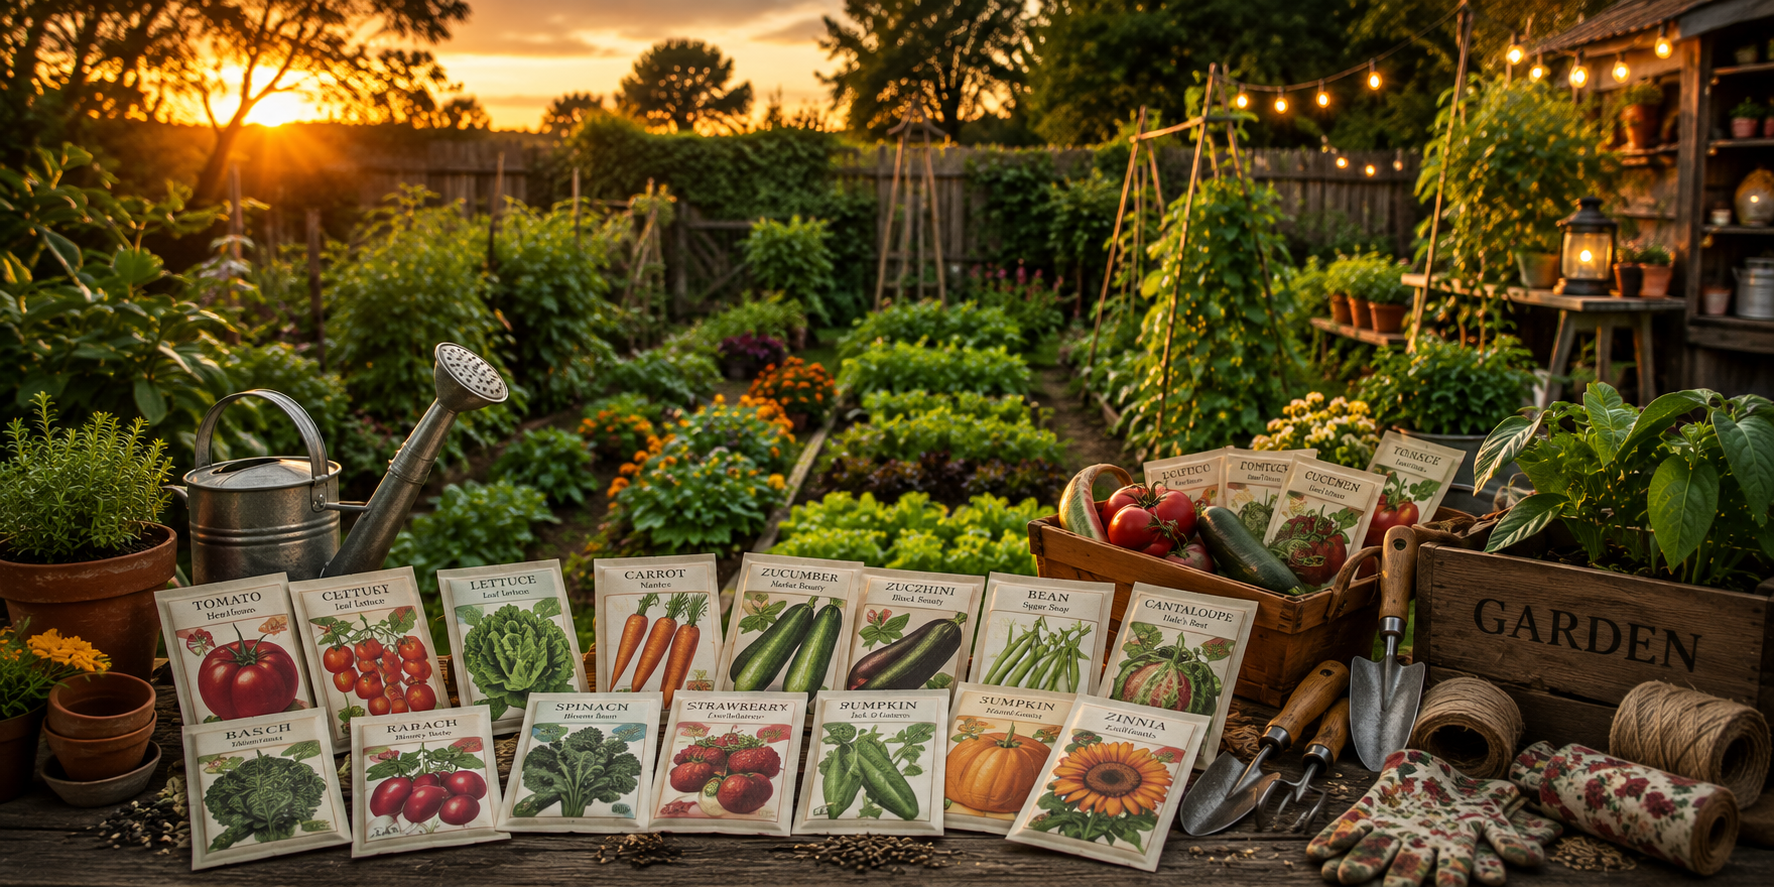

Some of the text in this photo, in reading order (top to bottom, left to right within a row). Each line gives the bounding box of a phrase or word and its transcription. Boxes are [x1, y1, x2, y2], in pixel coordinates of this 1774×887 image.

[470, 574, 537, 591] LETTUCE
[624, 568, 686, 580] CARROT
[761, 567, 839, 583] ZUCUMBER
[192, 591, 262, 611] TOMATO
[1028, 590, 1070, 602] BEAN
[1145, 599, 1234, 623] CANTALOUPE
[1473, 598, 1703, 673] GARDEN
[225, 722, 292, 740] BASCH
[1104, 712, 1166, 732] ZINNIA
